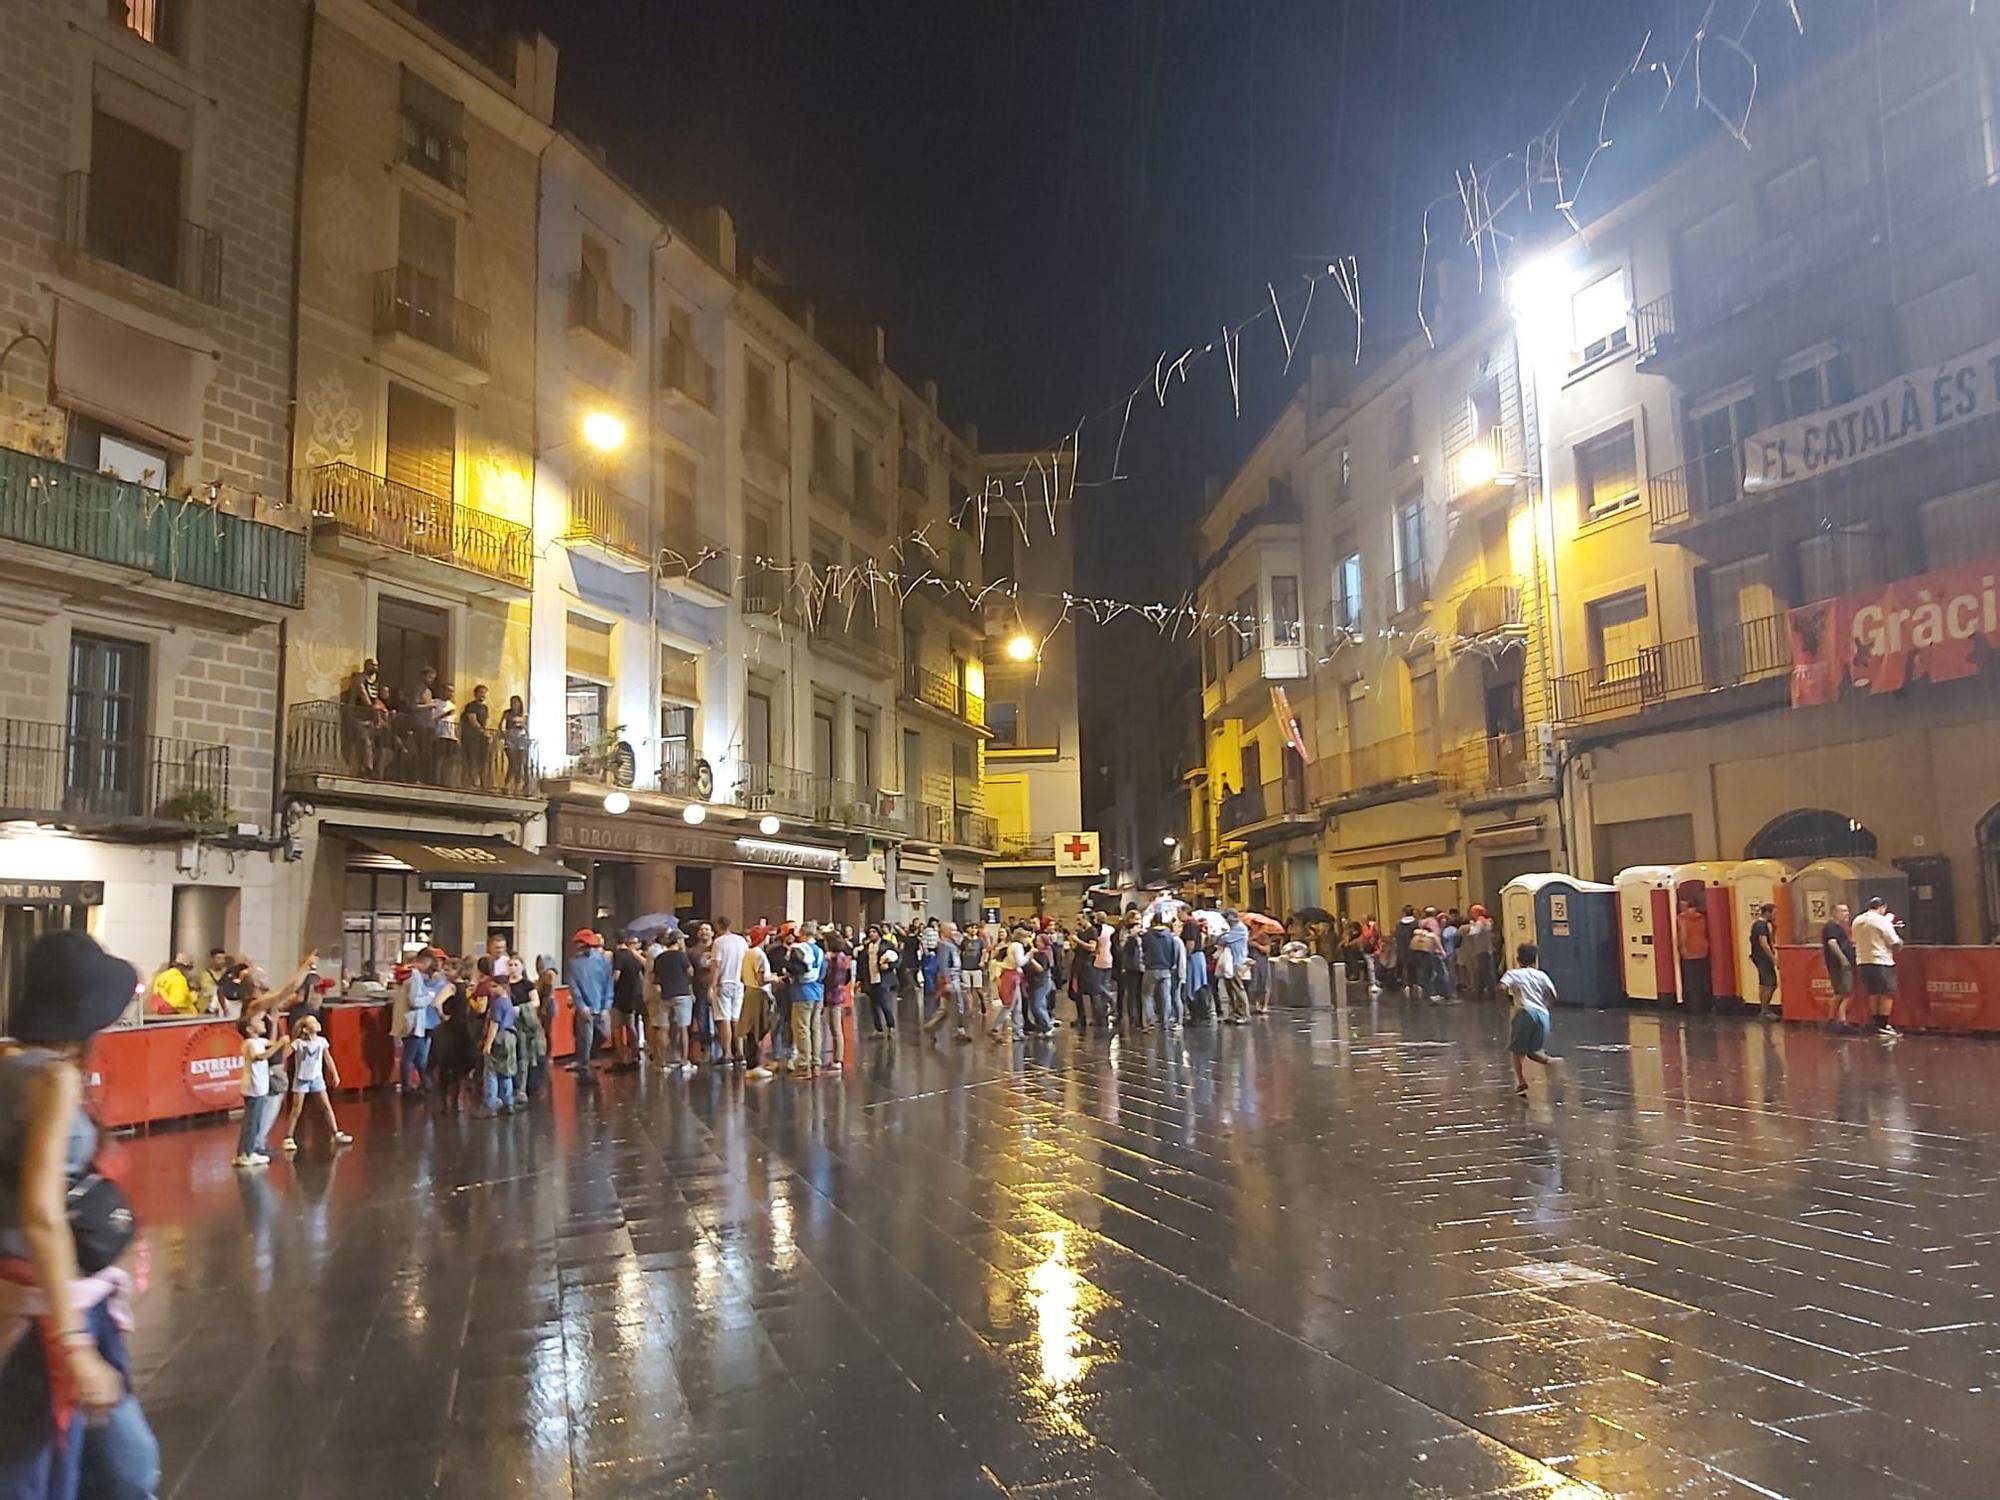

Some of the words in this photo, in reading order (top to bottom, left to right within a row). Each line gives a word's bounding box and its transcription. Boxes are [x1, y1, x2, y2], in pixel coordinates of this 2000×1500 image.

[1802, 379, 1924, 471] CATALÀ
[1932, 364, 1977, 426] ÉS
[28, 885, 61, 898] BAR
[1927, 981, 1978, 992] ESTRELLA
[191, 1056, 245, 1074] ESTRELLA
